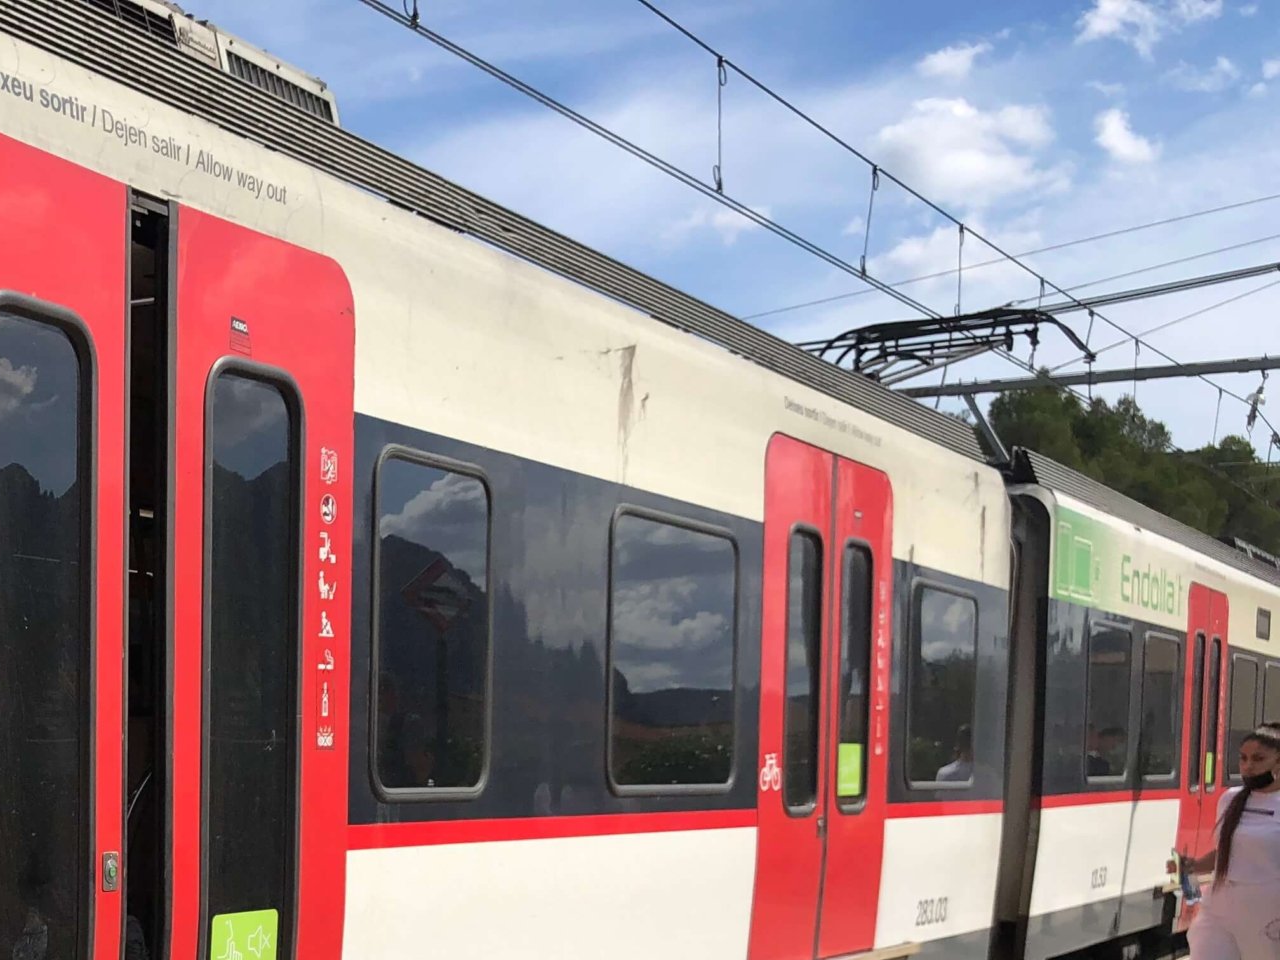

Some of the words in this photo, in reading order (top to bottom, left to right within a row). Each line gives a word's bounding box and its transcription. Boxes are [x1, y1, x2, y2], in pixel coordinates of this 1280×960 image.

[39, 88, 87, 123] sortir
[101, 108, 147, 147] Dejen
[151, 136, 182, 162] salir
[195, 149, 233, 182] Allow
[236, 170, 263, 200] way
[266, 183, 287, 205] out
